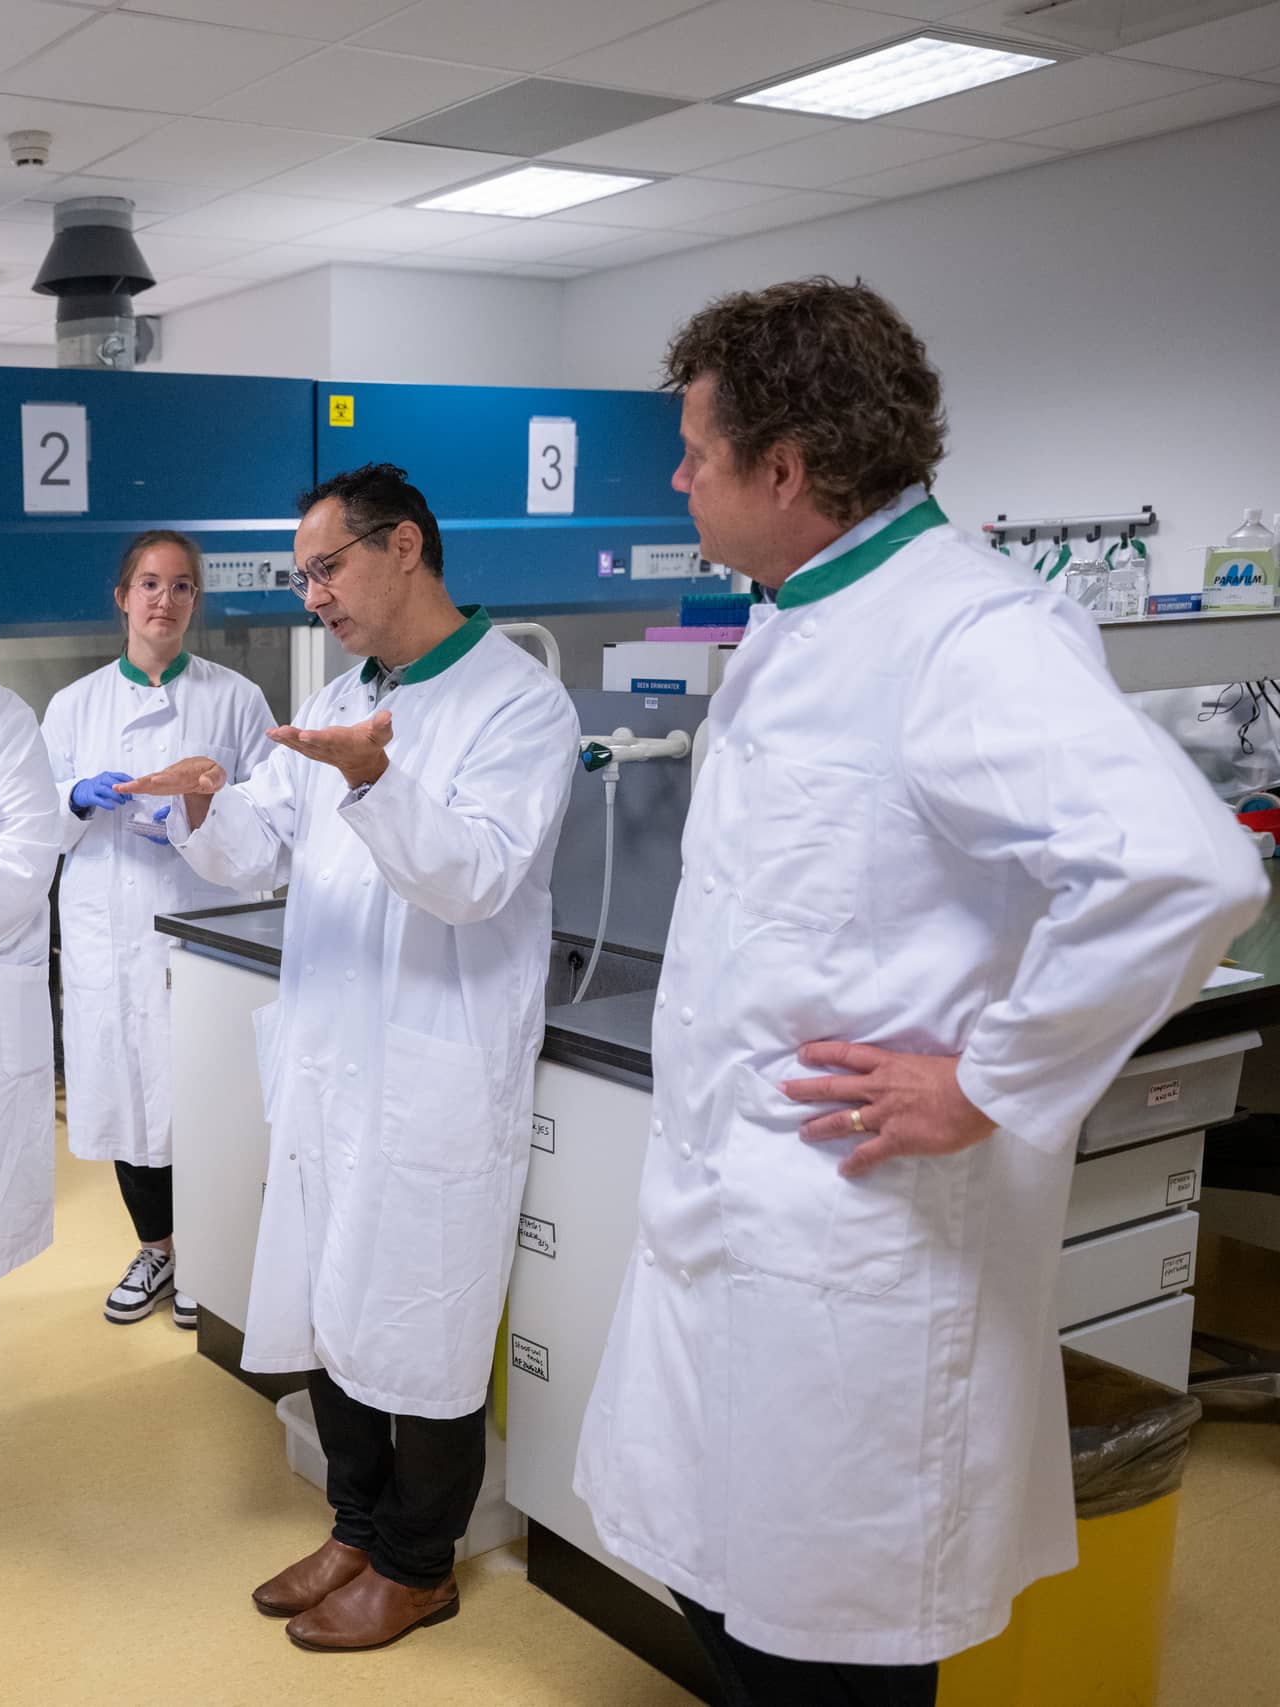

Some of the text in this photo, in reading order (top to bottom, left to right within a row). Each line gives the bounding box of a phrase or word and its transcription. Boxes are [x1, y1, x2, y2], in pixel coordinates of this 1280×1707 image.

[39, 431, 71, 486] 2
[541, 444, 563, 491] 3
[1213, 574, 1263, 585] PARAFILM
